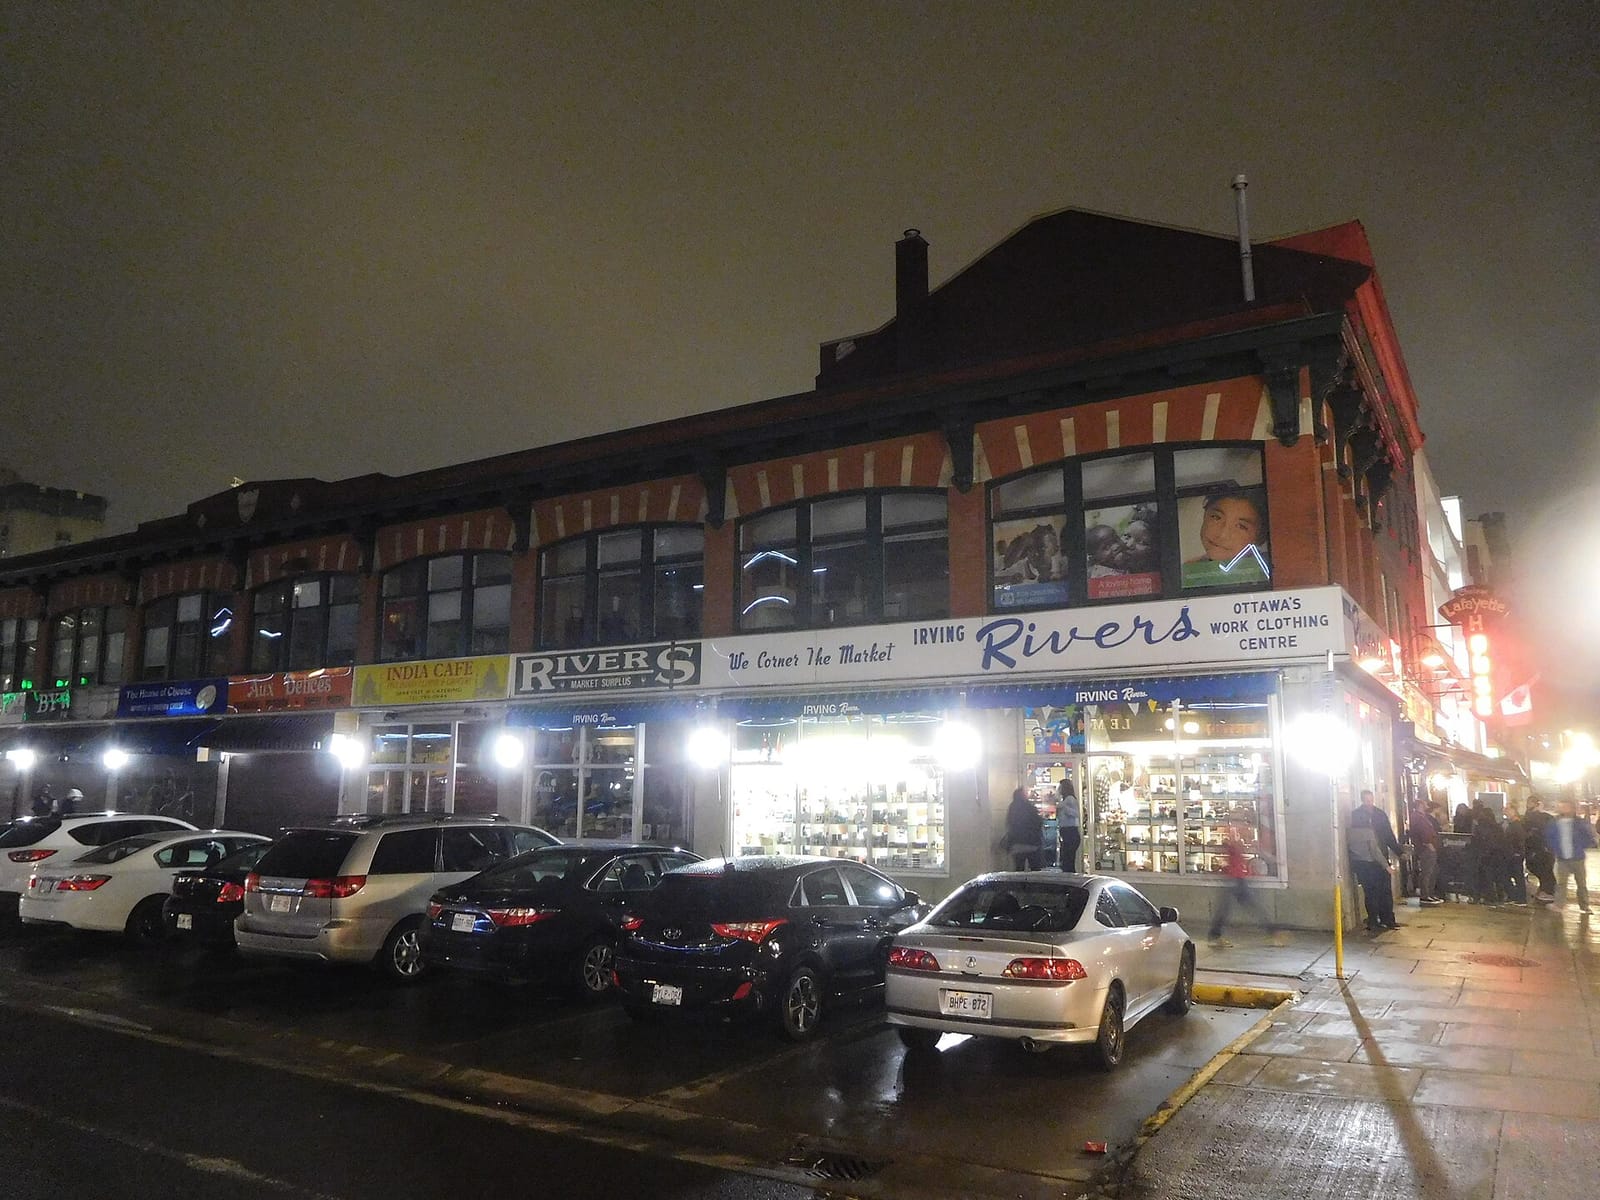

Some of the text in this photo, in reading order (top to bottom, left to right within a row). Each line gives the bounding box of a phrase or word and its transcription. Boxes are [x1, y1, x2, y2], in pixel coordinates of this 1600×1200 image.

[1233, 597, 1301, 614] OTTAWA'S
[1442, 598, 1505, 617] Lafayette
[1210, 615, 1329, 635] WORK CLOTHING
[913, 605, 1200, 670] IRVING Rivers
[1239, 635, 1298, 650] CENTRE
[728, 643, 895, 670] We Corner The Market
[386, 660, 474, 681] INDIA CAFE
[570, 676, 632, 689] MARKET SURPLUS
[1075, 689, 1118, 703] IRVING
[803, 704, 836, 714] IRVING
[572, 714, 598, 723] IRVING
[972, 999, 987, 1011] 872
